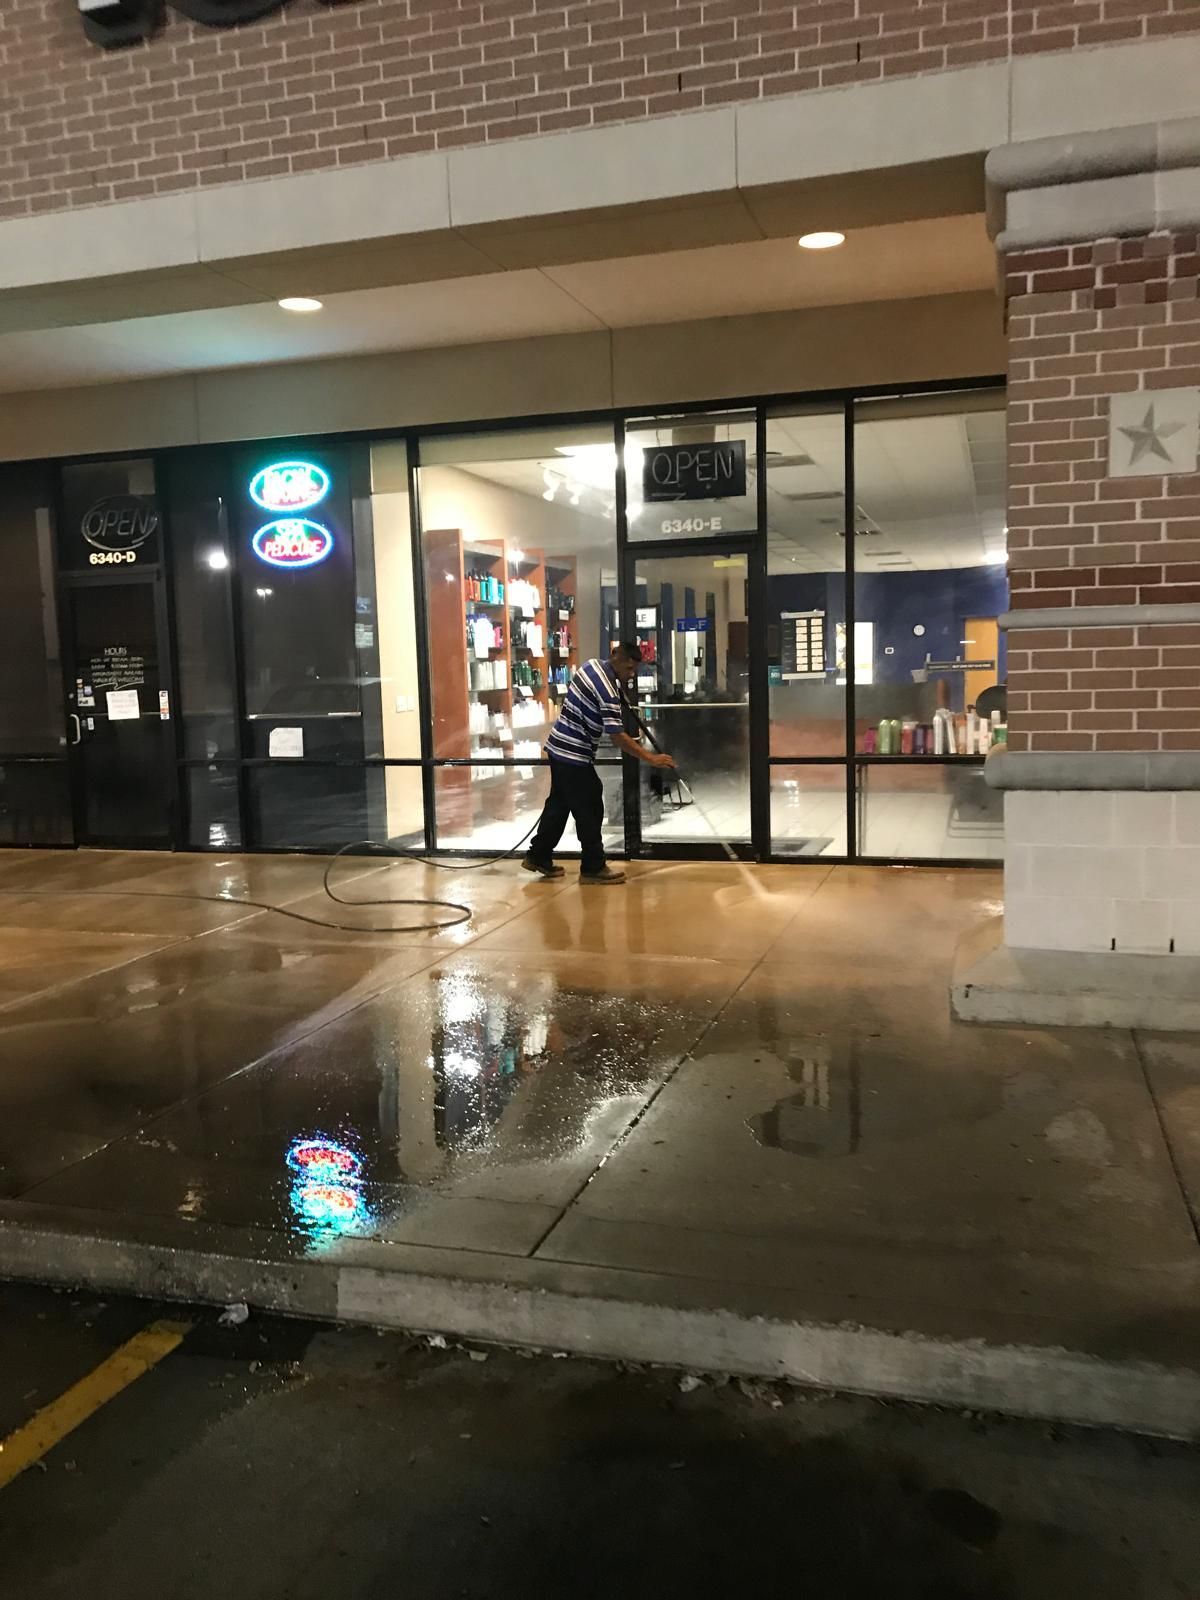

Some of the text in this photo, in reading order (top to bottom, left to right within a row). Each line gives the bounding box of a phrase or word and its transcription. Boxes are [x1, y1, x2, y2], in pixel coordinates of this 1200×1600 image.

[652, 448, 735, 485] OPEN
[86, 507, 150, 537] OPEN
[661, 516, 722, 533] 6340-E
[89, 550, 136, 565] 6340-D
[264, 539, 325, 559] PEDICURE
[104, 646, 128, 656] HOURS
